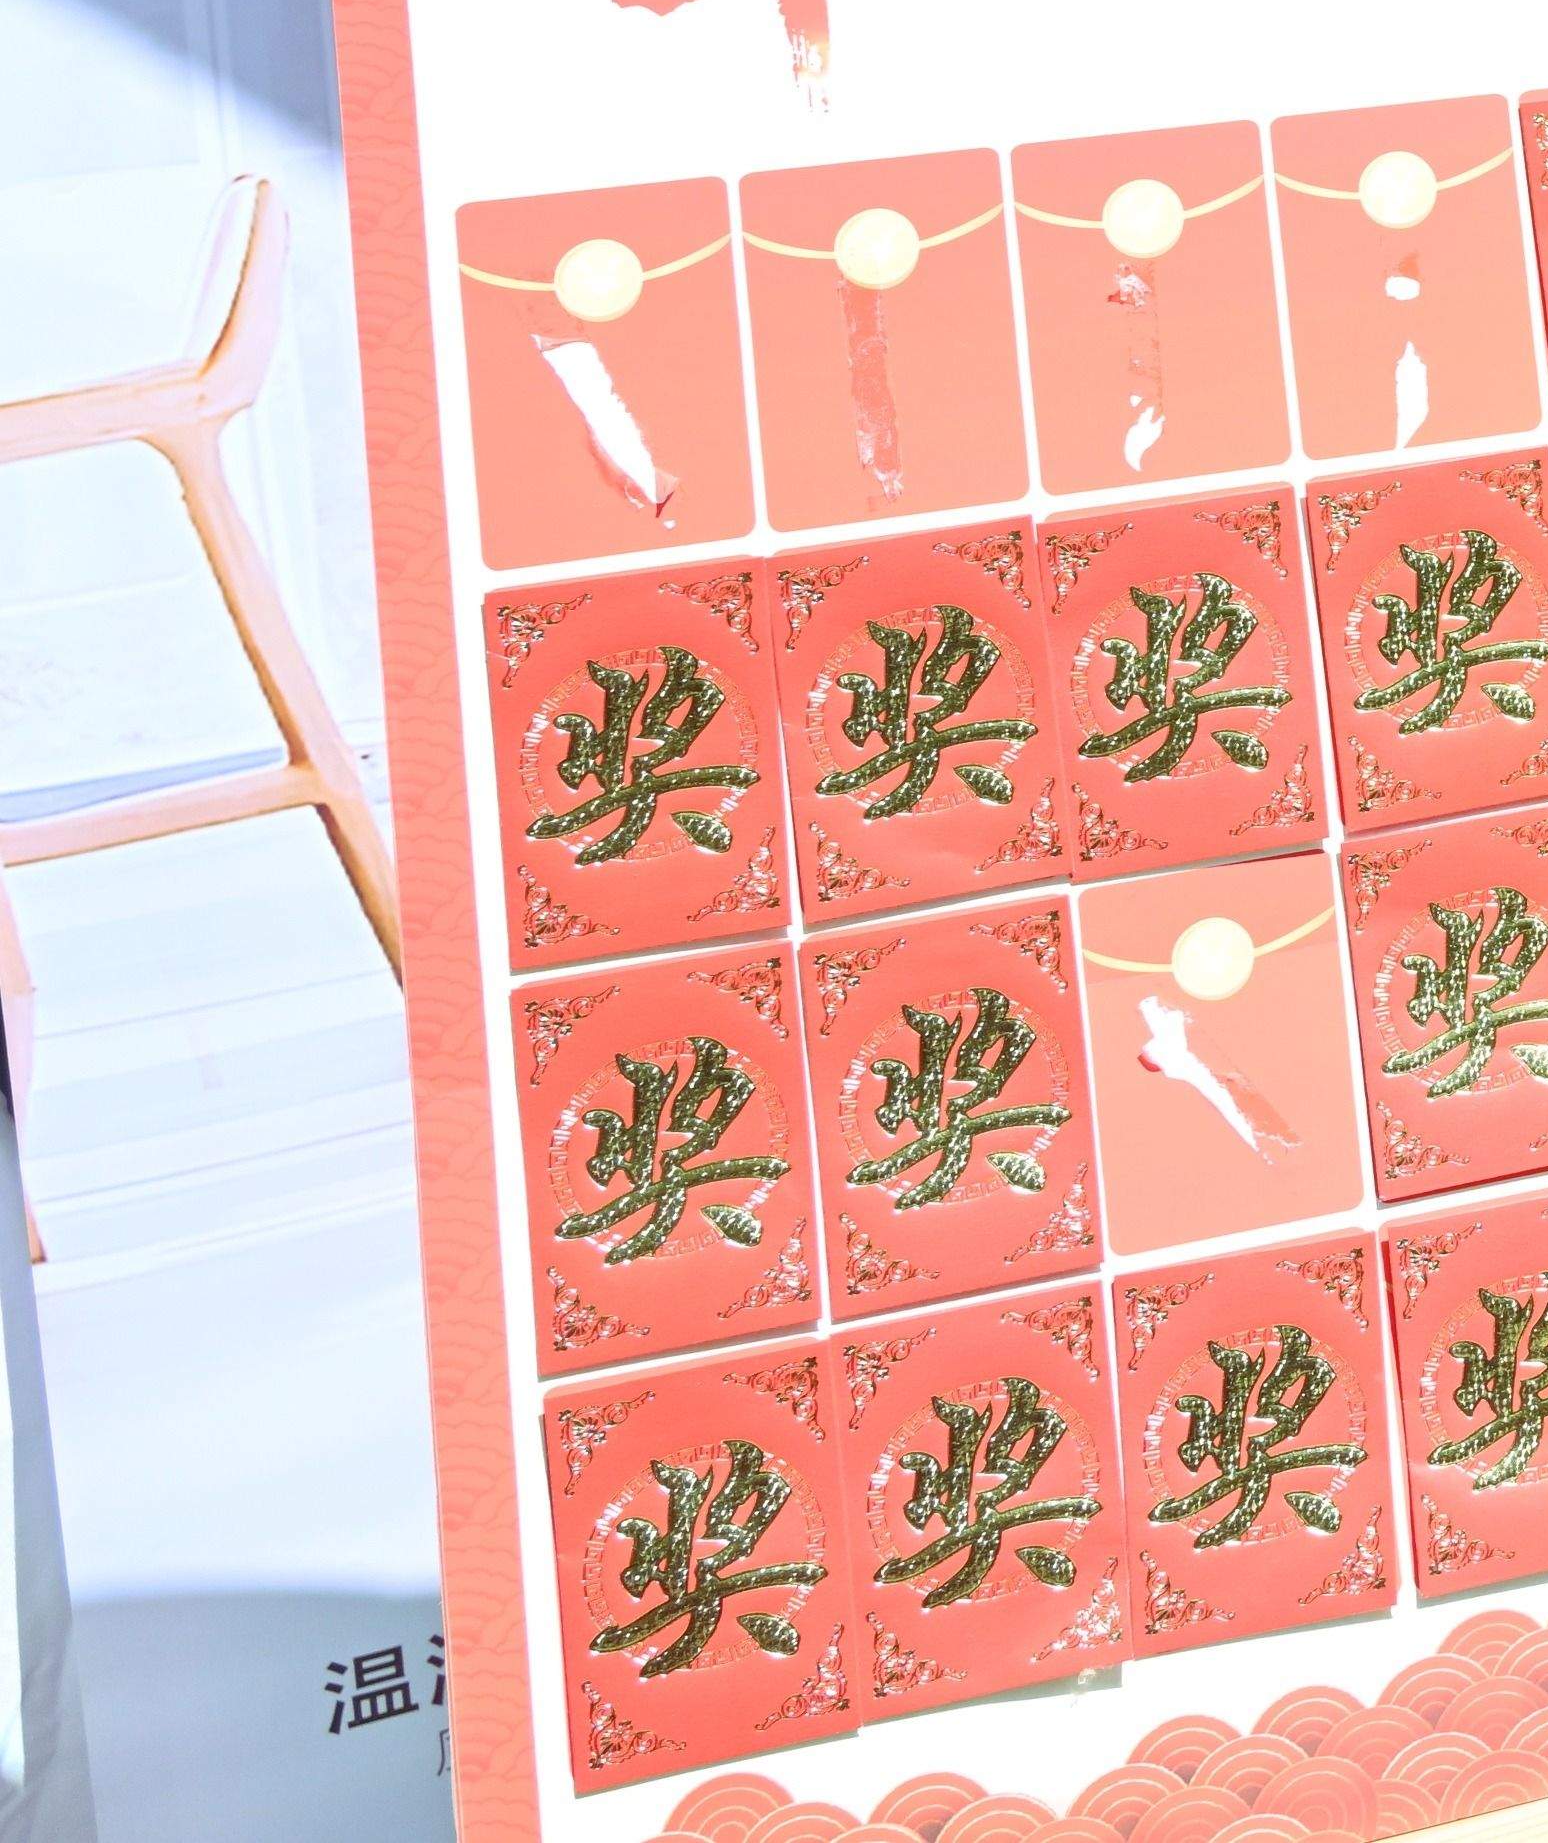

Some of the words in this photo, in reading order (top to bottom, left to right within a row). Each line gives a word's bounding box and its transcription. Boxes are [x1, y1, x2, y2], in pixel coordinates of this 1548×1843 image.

[528, 650, 758, 865] 奖
[817, 609, 1037, 819] 奖
[1079, 580, 1290, 782] 奖
[555, 1038, 789, 1263] 奖
[845, 988, 1070, 1209] 奖
[876, 1380, 1102, 1606] 奖
[1155, 1324, 1366, 1549] 奖
[590, 1441, 823, 1678] 奖
[324, 1634, 452, 1736] 温
